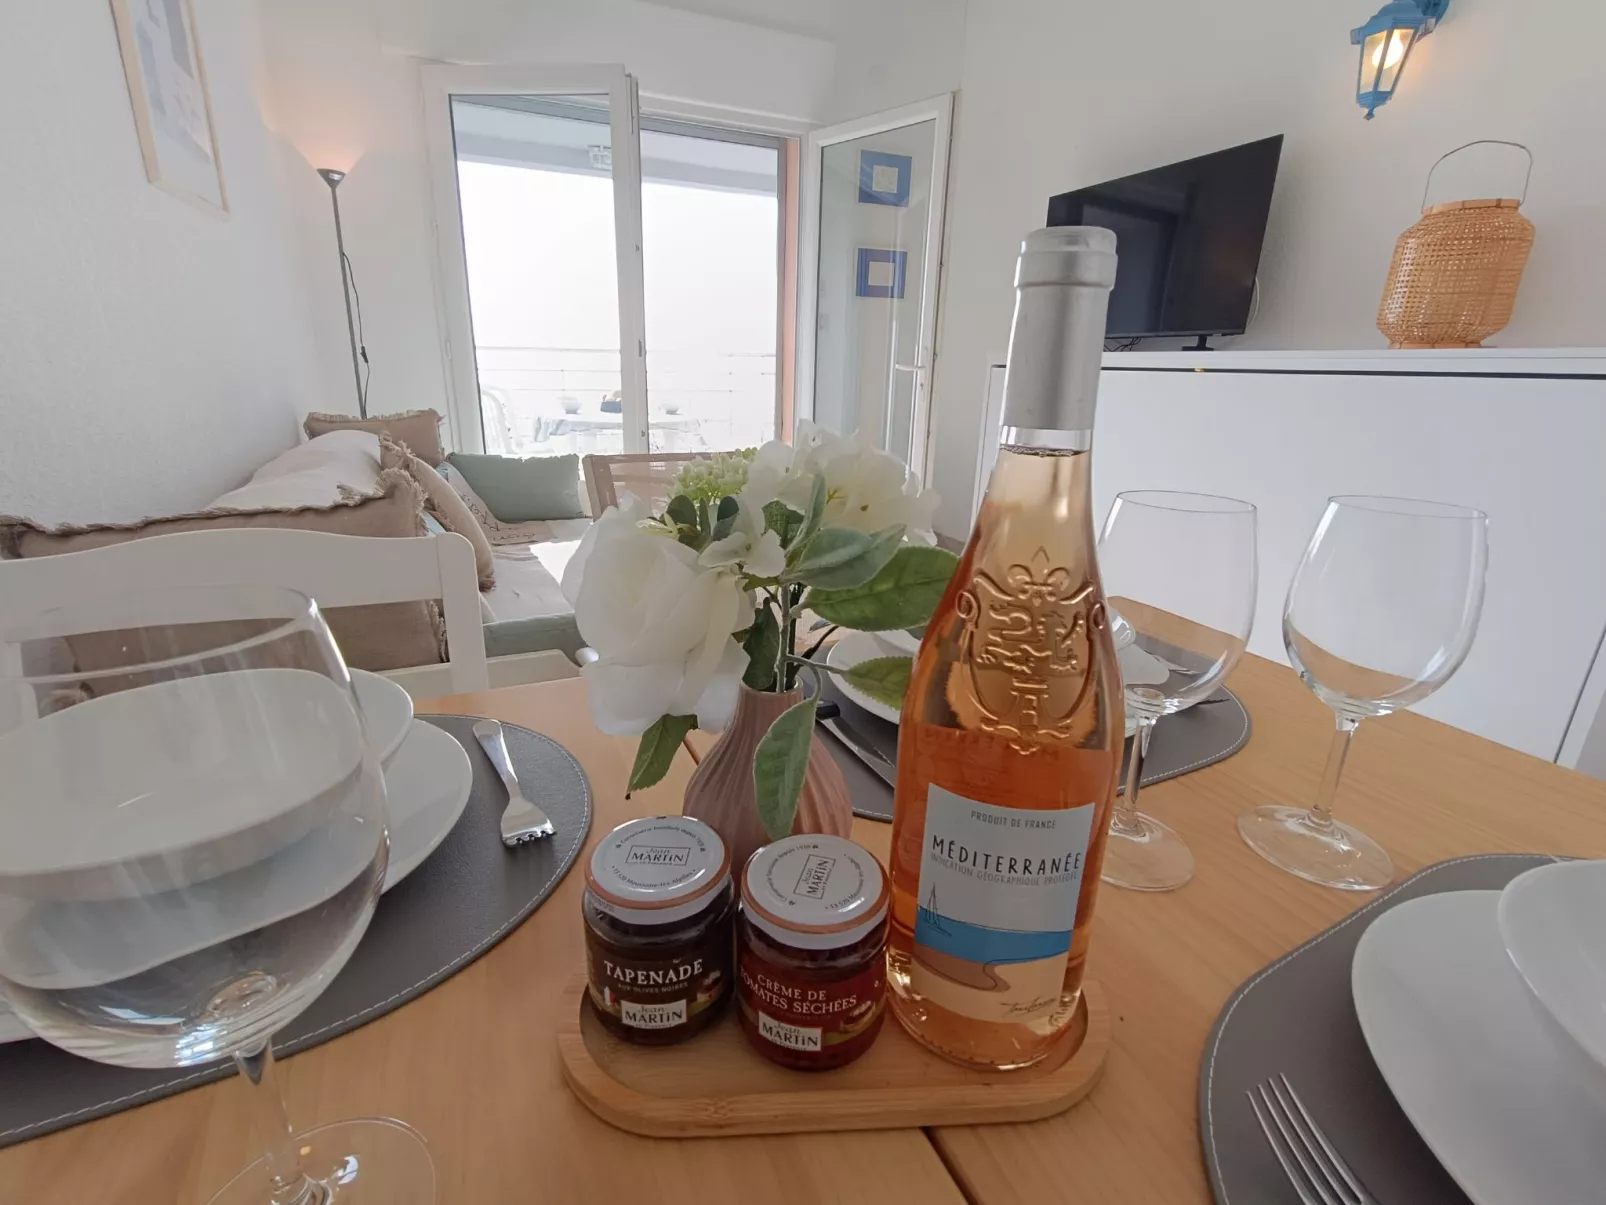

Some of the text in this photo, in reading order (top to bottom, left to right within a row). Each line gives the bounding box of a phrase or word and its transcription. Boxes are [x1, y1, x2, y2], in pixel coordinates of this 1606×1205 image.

[971, 810, 1057, 830] PRODUIT DE FRANCE
[932, 834, 1081, 876] MÉDITERRANÉE
[930, 852, 973, 877] INDICATION
[976, 870, 1040, 887] GÉOGRAPHIQUE
[604, 959, 703, 985] TAPENADE
[757, 974, 826, 1001] CRÈME DE
[637, 1005, 666, 1013] Jean
[793, 995, 857, 1015] SÉCHÉES
